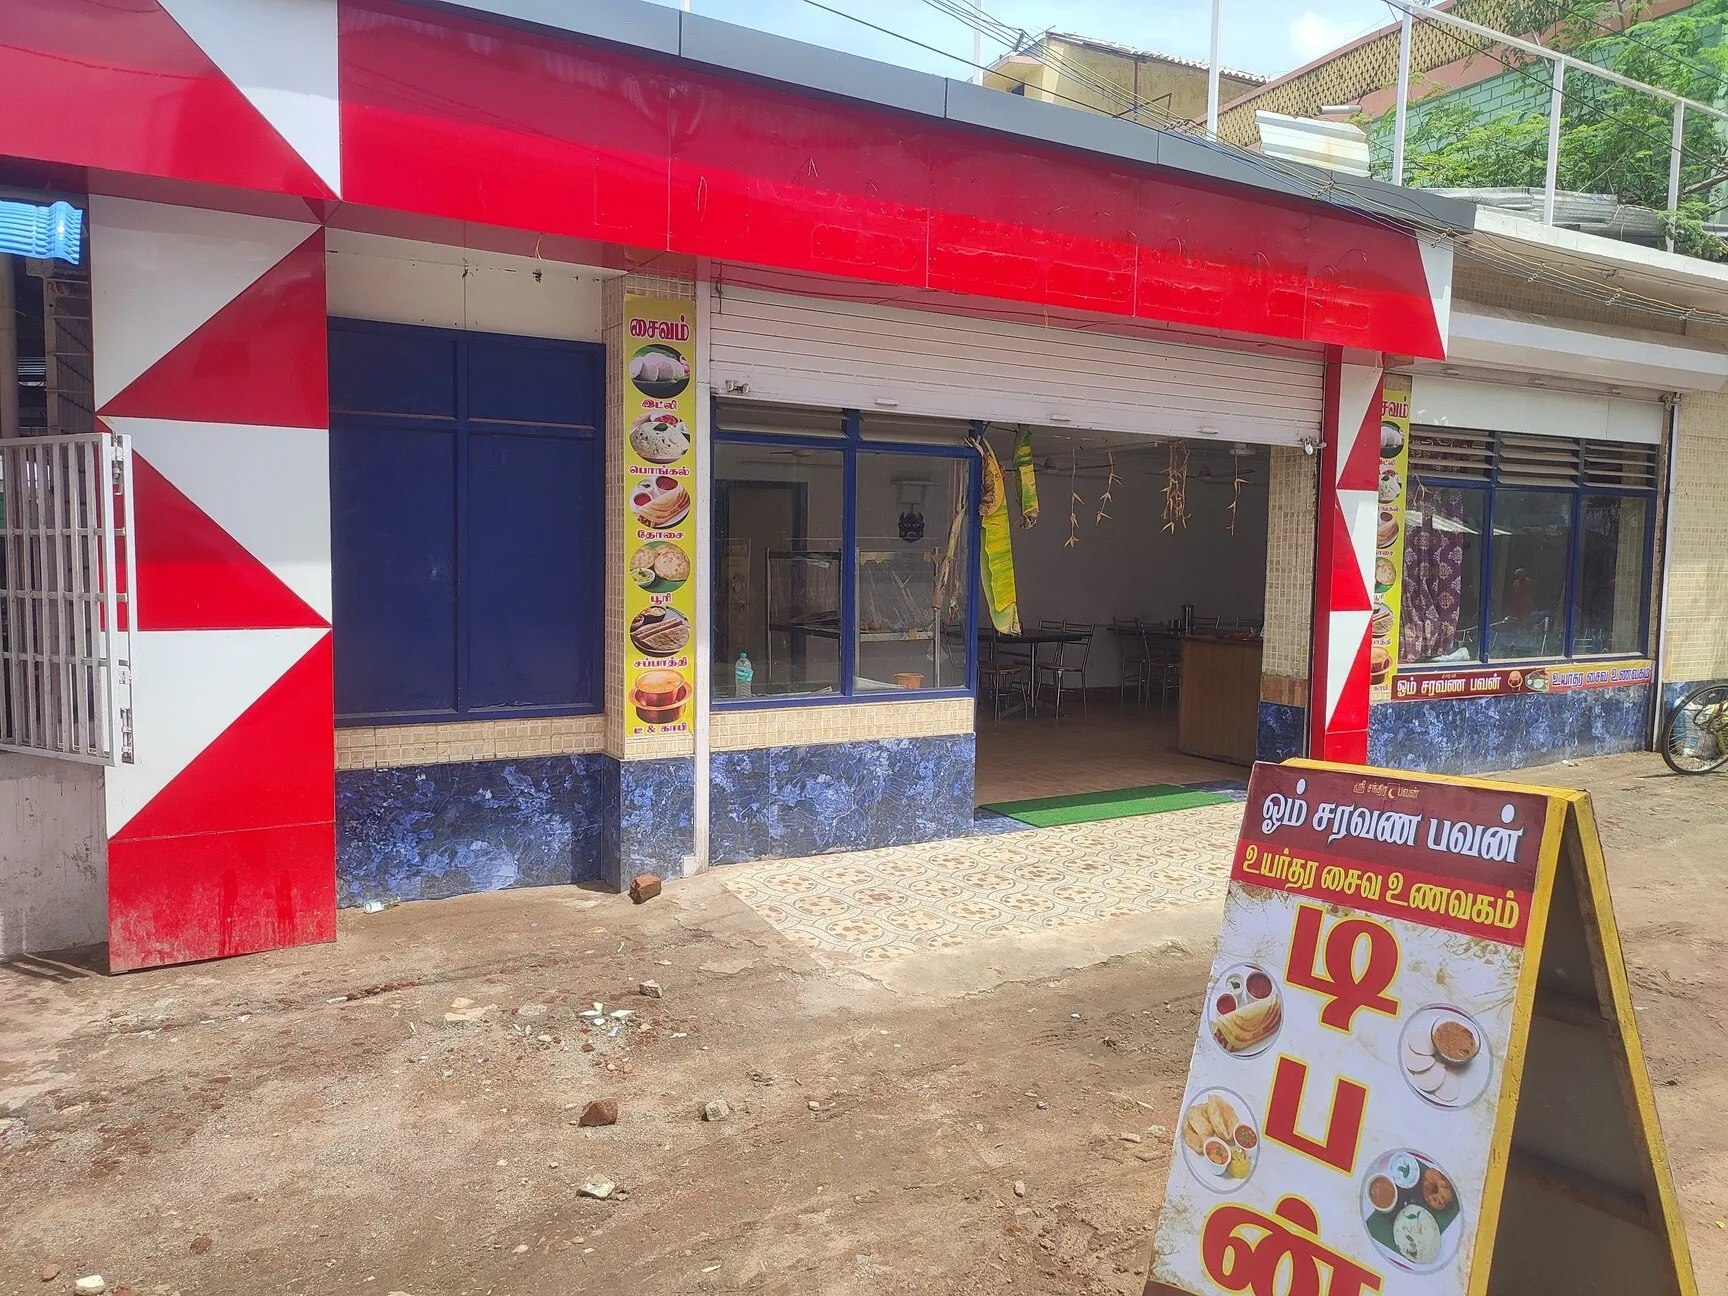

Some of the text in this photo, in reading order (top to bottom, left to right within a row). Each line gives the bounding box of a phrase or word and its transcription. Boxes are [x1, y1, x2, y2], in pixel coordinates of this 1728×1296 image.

[630, 315, 690, 341] சைவம்
[642, 400, 677, 410] இட்லி
[629, 465, 690, 476] பொங்கல்
[637, 529, 684, 540] தோசை
[650, 593, 672, 605] பூரி
[633, 657, 688, 668] சப்பாத்தி
[1552, 664, 1652, 687] உயர்தர சைவ உணவகம்
[1397, 672, 1502, 697] ஓம் சரவண பவன்
[647, 725, 656, 734] &
[660, 723, 688, 733] காபி
[1262, 778, 1524, 864] ஓம் சரவண பவன்
[1242, 844, 1520, 930] உயர்தர சைவ உணவகம்
